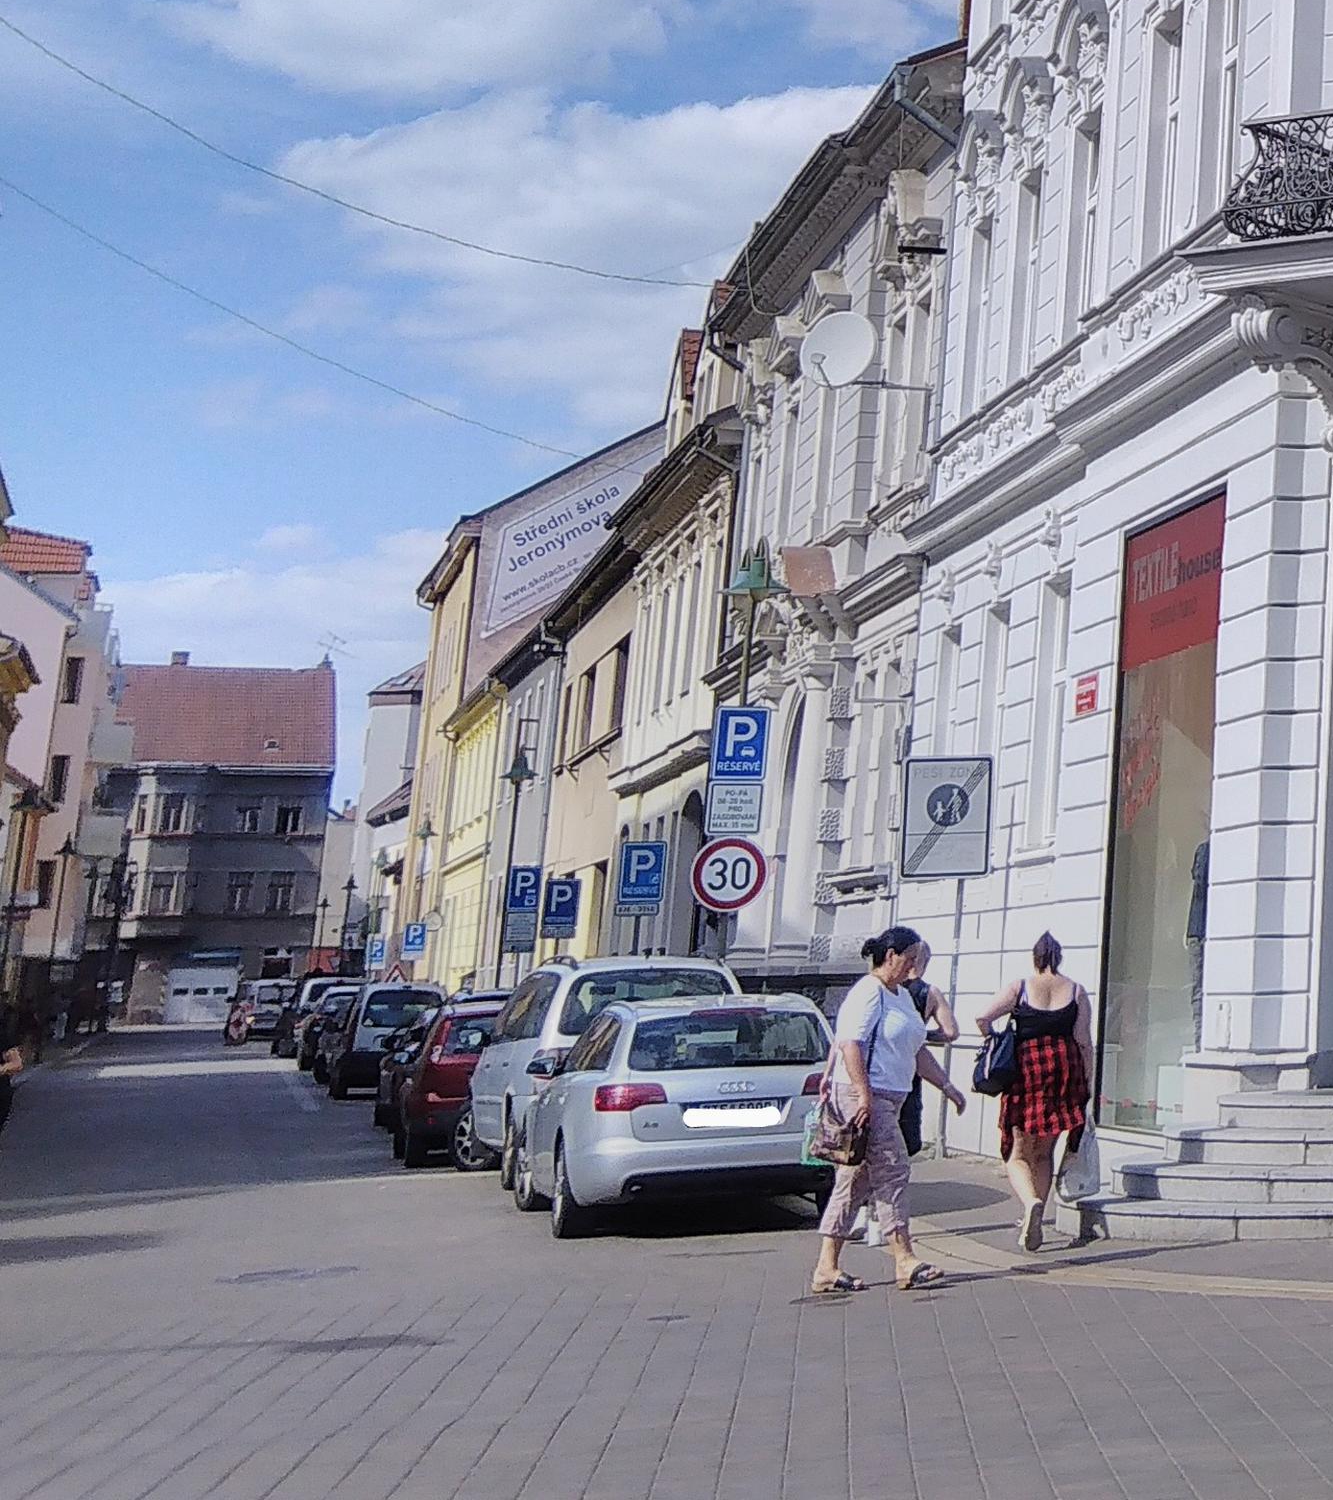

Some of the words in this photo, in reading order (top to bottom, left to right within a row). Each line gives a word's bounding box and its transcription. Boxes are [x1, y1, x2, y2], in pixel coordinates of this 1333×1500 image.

[513, 507, 574, 547] Střední
[576, 485, 621, 515] škola
[508, 510, 613, 572] Jeronýmova
[725, 716, 758, 757] P
[630, 849, 656, 883] P
[707, 857, 751, 891] 30
[515, 871, 536, 896] P
[551, 885, 572, 912] P
[409, 926, 422, 942] P
